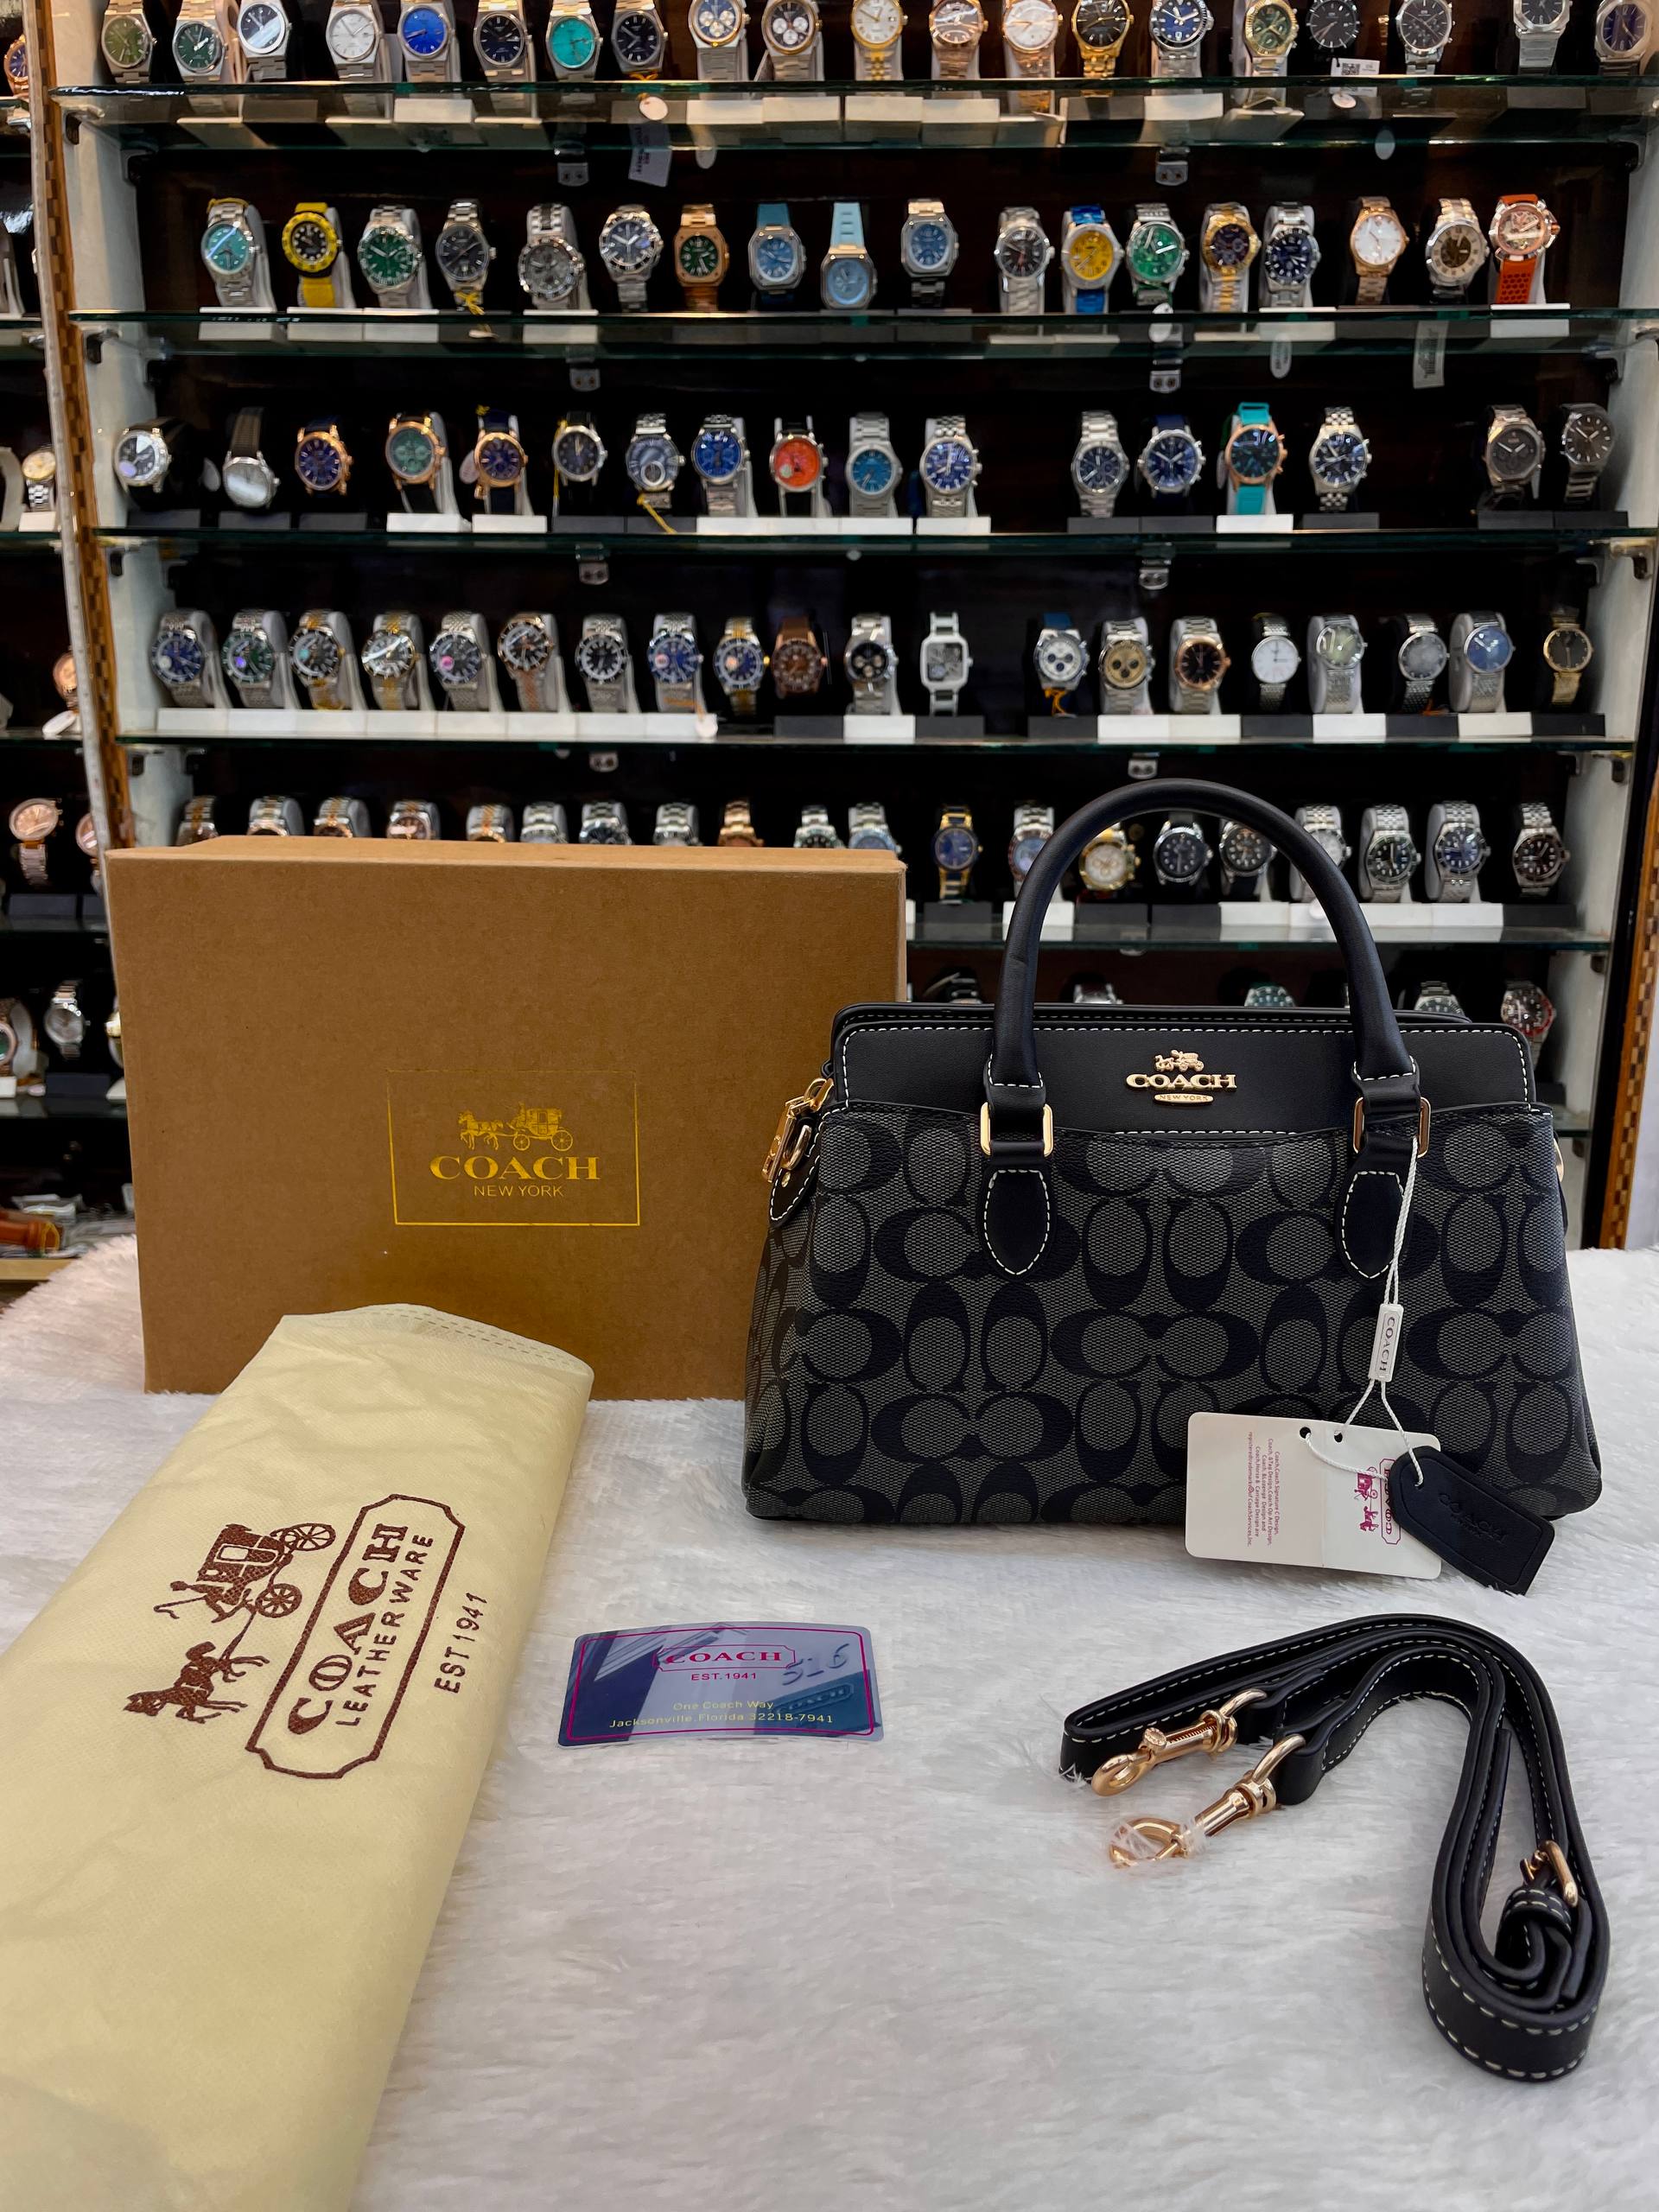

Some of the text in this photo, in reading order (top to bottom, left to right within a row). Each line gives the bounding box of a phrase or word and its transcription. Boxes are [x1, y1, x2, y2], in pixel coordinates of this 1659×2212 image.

[1126, 1073, 1237, 1090] COACH
[429, 1156, 601, 1180] COACH
[474, 1185, 563, 1198] NEW YORK
[1379, 1316, 1395, 1371] COACH
[287, 1522, 409, 1735] COACH
[335, 1534, 434, 1726] LEATHERWARE
[664, 1650, 783, 1663] COACH
[691, 1672, 757, 1681] EST.1941
[673, 1700, 774, 1712] One Coach Way
[748, 1713, 833, 1723] 32218-7941
